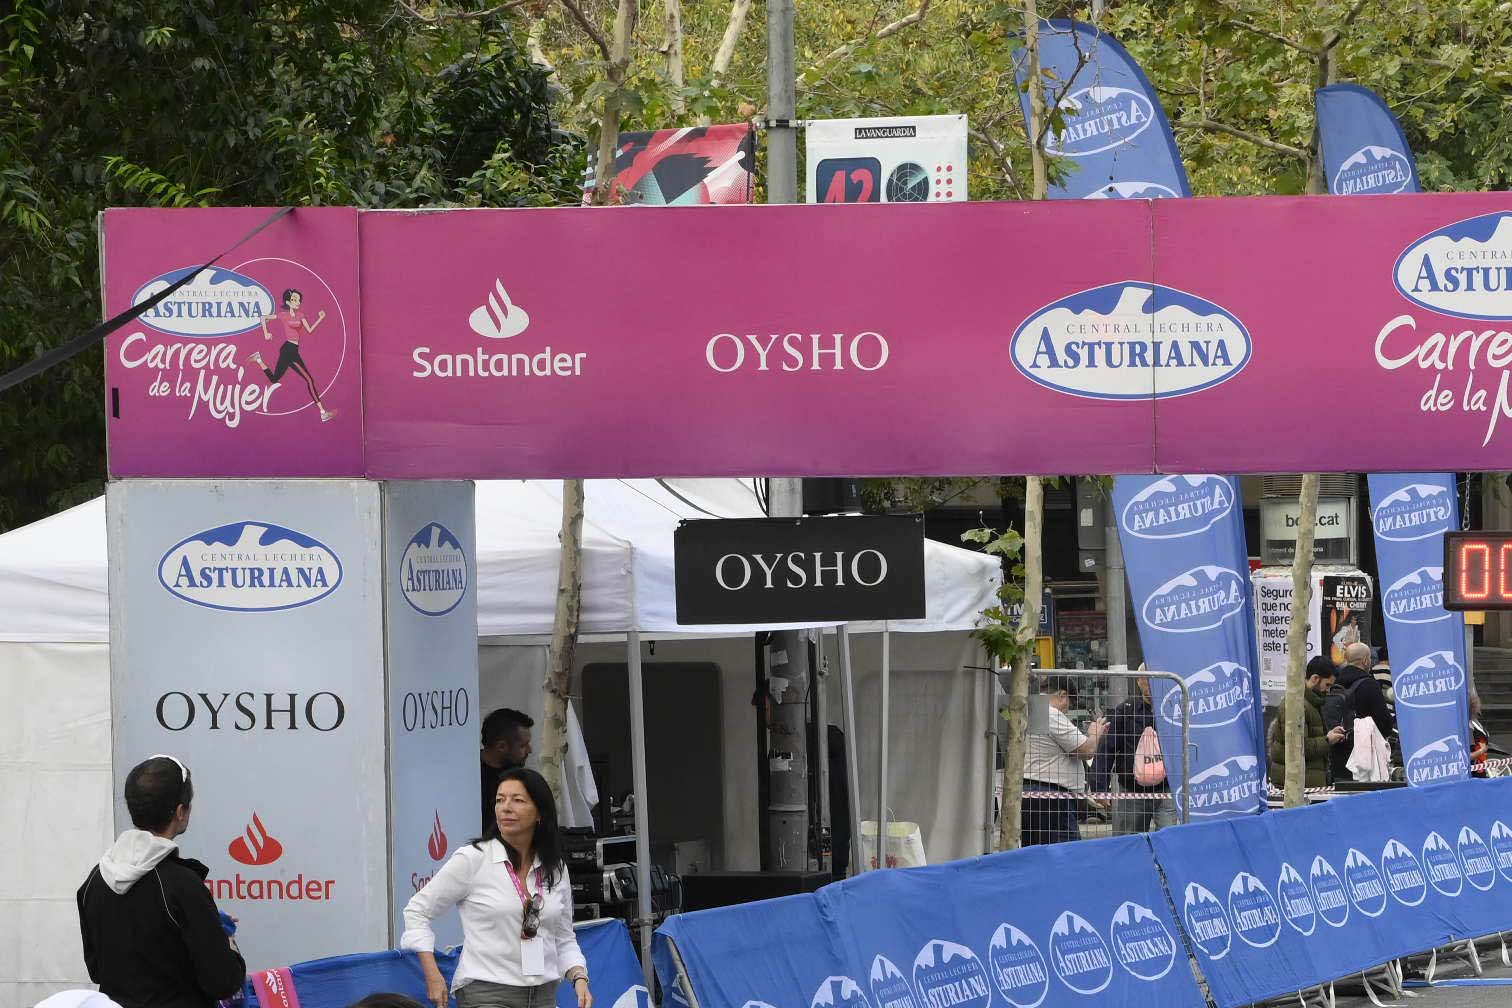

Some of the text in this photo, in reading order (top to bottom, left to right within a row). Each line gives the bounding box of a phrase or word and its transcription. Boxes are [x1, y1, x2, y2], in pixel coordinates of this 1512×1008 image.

[1065, 323, 1142, 334] CENTRAL
[119, 332, 238, 370] Carrera
[412, 346, 587, 378] Santander
[705, 332, 890, 373] OYSHO
[1030, 326, 1234, 371] ASTURIANA
[149, 366, 282, 429] de la Mujer
[1420, 375, 1455, 412] de
[1463, 374, 1487, 412] la
[173, 555, 329, 590] ASTURIANA
[201, 552, 322, 562] CENTRAL LECHERA
[715, 549, 888, 590] OYSHO
[405, 561, 463, 592] ASTURIANA
[1336, 585, 1368, 597] ELVIS
[1262, 602, 1277, 613] que
[1263, 641, 1281, 651] este
[155, 691, 345, 732] OYSHO
[402, 687, 469, 732] OYSHO
[203, 873, 336, 901] antander
[1056, 945, 1110, 977] ASTURIANA
